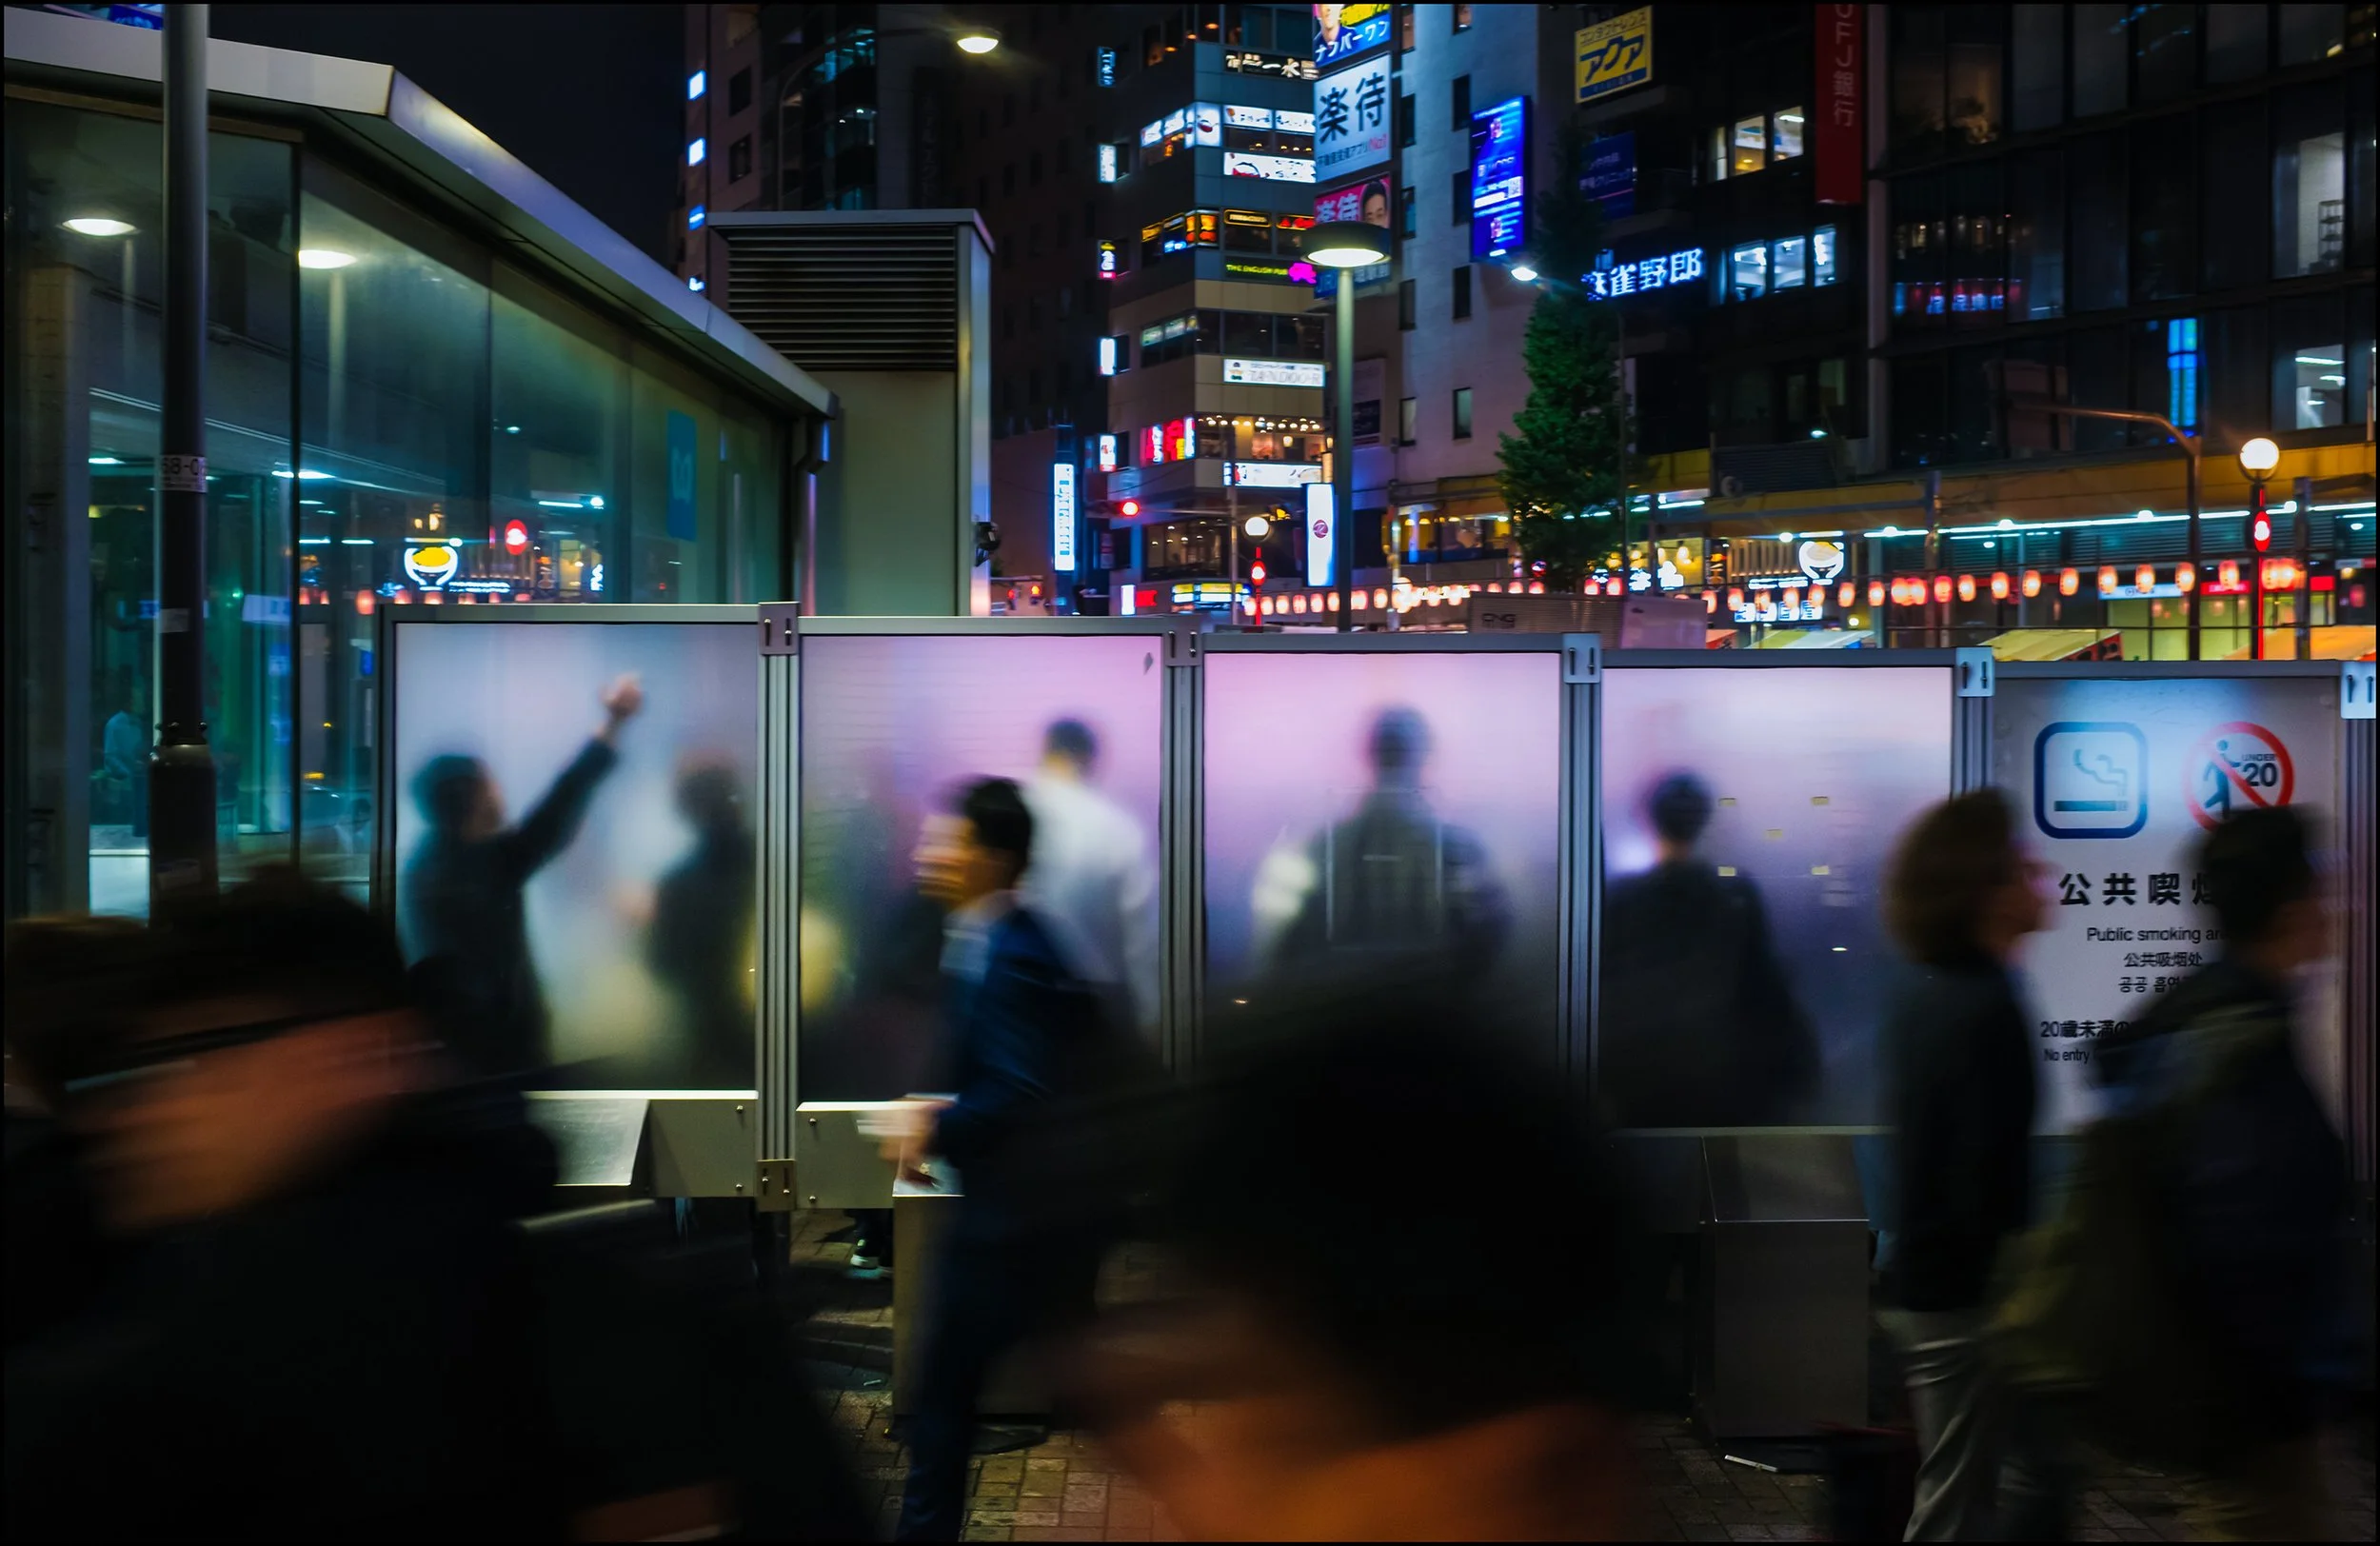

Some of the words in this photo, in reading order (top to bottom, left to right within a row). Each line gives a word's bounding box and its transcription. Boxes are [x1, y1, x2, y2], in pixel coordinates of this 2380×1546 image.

[1580, 34, 1644, 83] アクア
[1319, 71, 1385, 144] 楽待
[2241, 753, 2277, 762] UNDER
[2242, 762, 2277, 787] 20
[2086, 926, 2133, 941] Public
[2136, 926, 2201, 944] smoking
[2123, 952, 2203, 968] 公共吸烟处
[2118, 976, 2149, 994] 공공
[2043, 1049, 2060, 1062] No
[2062, 1048, 2091, 1064] entry
